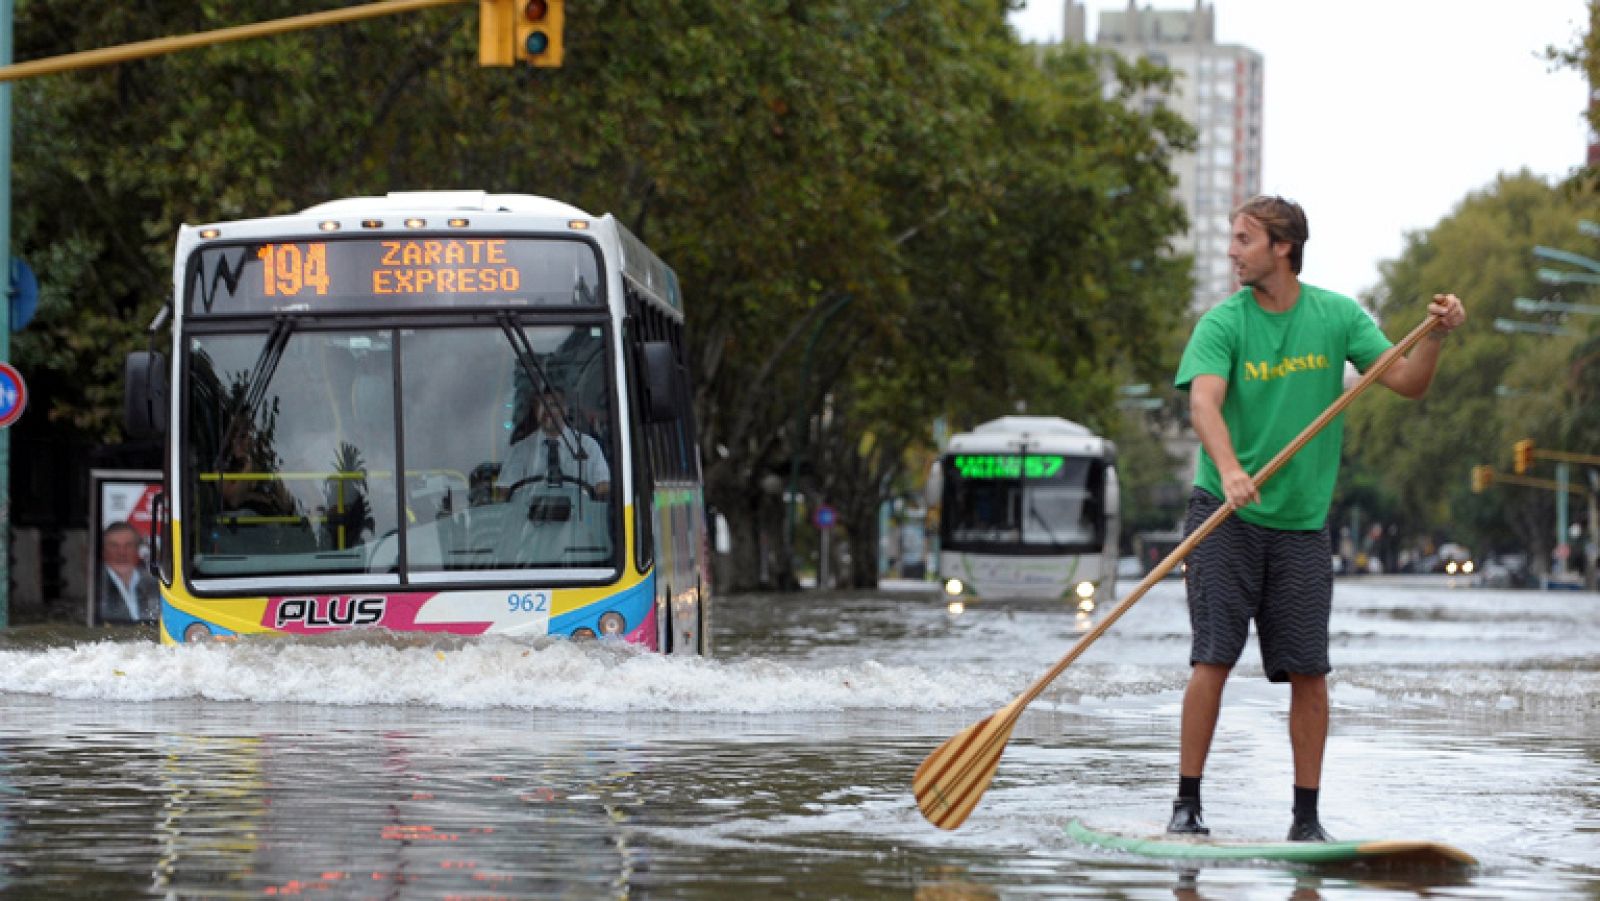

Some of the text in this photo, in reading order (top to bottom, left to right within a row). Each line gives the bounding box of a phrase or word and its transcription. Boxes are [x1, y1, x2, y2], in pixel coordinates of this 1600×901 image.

[381, 239, 507, 266] ZARATE
[257, 243, 330, 296] 194
[372, 268, 520, 294] EXPRESO
[274, 597, 386, 628] PLUS
[507, 593, 548, 613] 962
